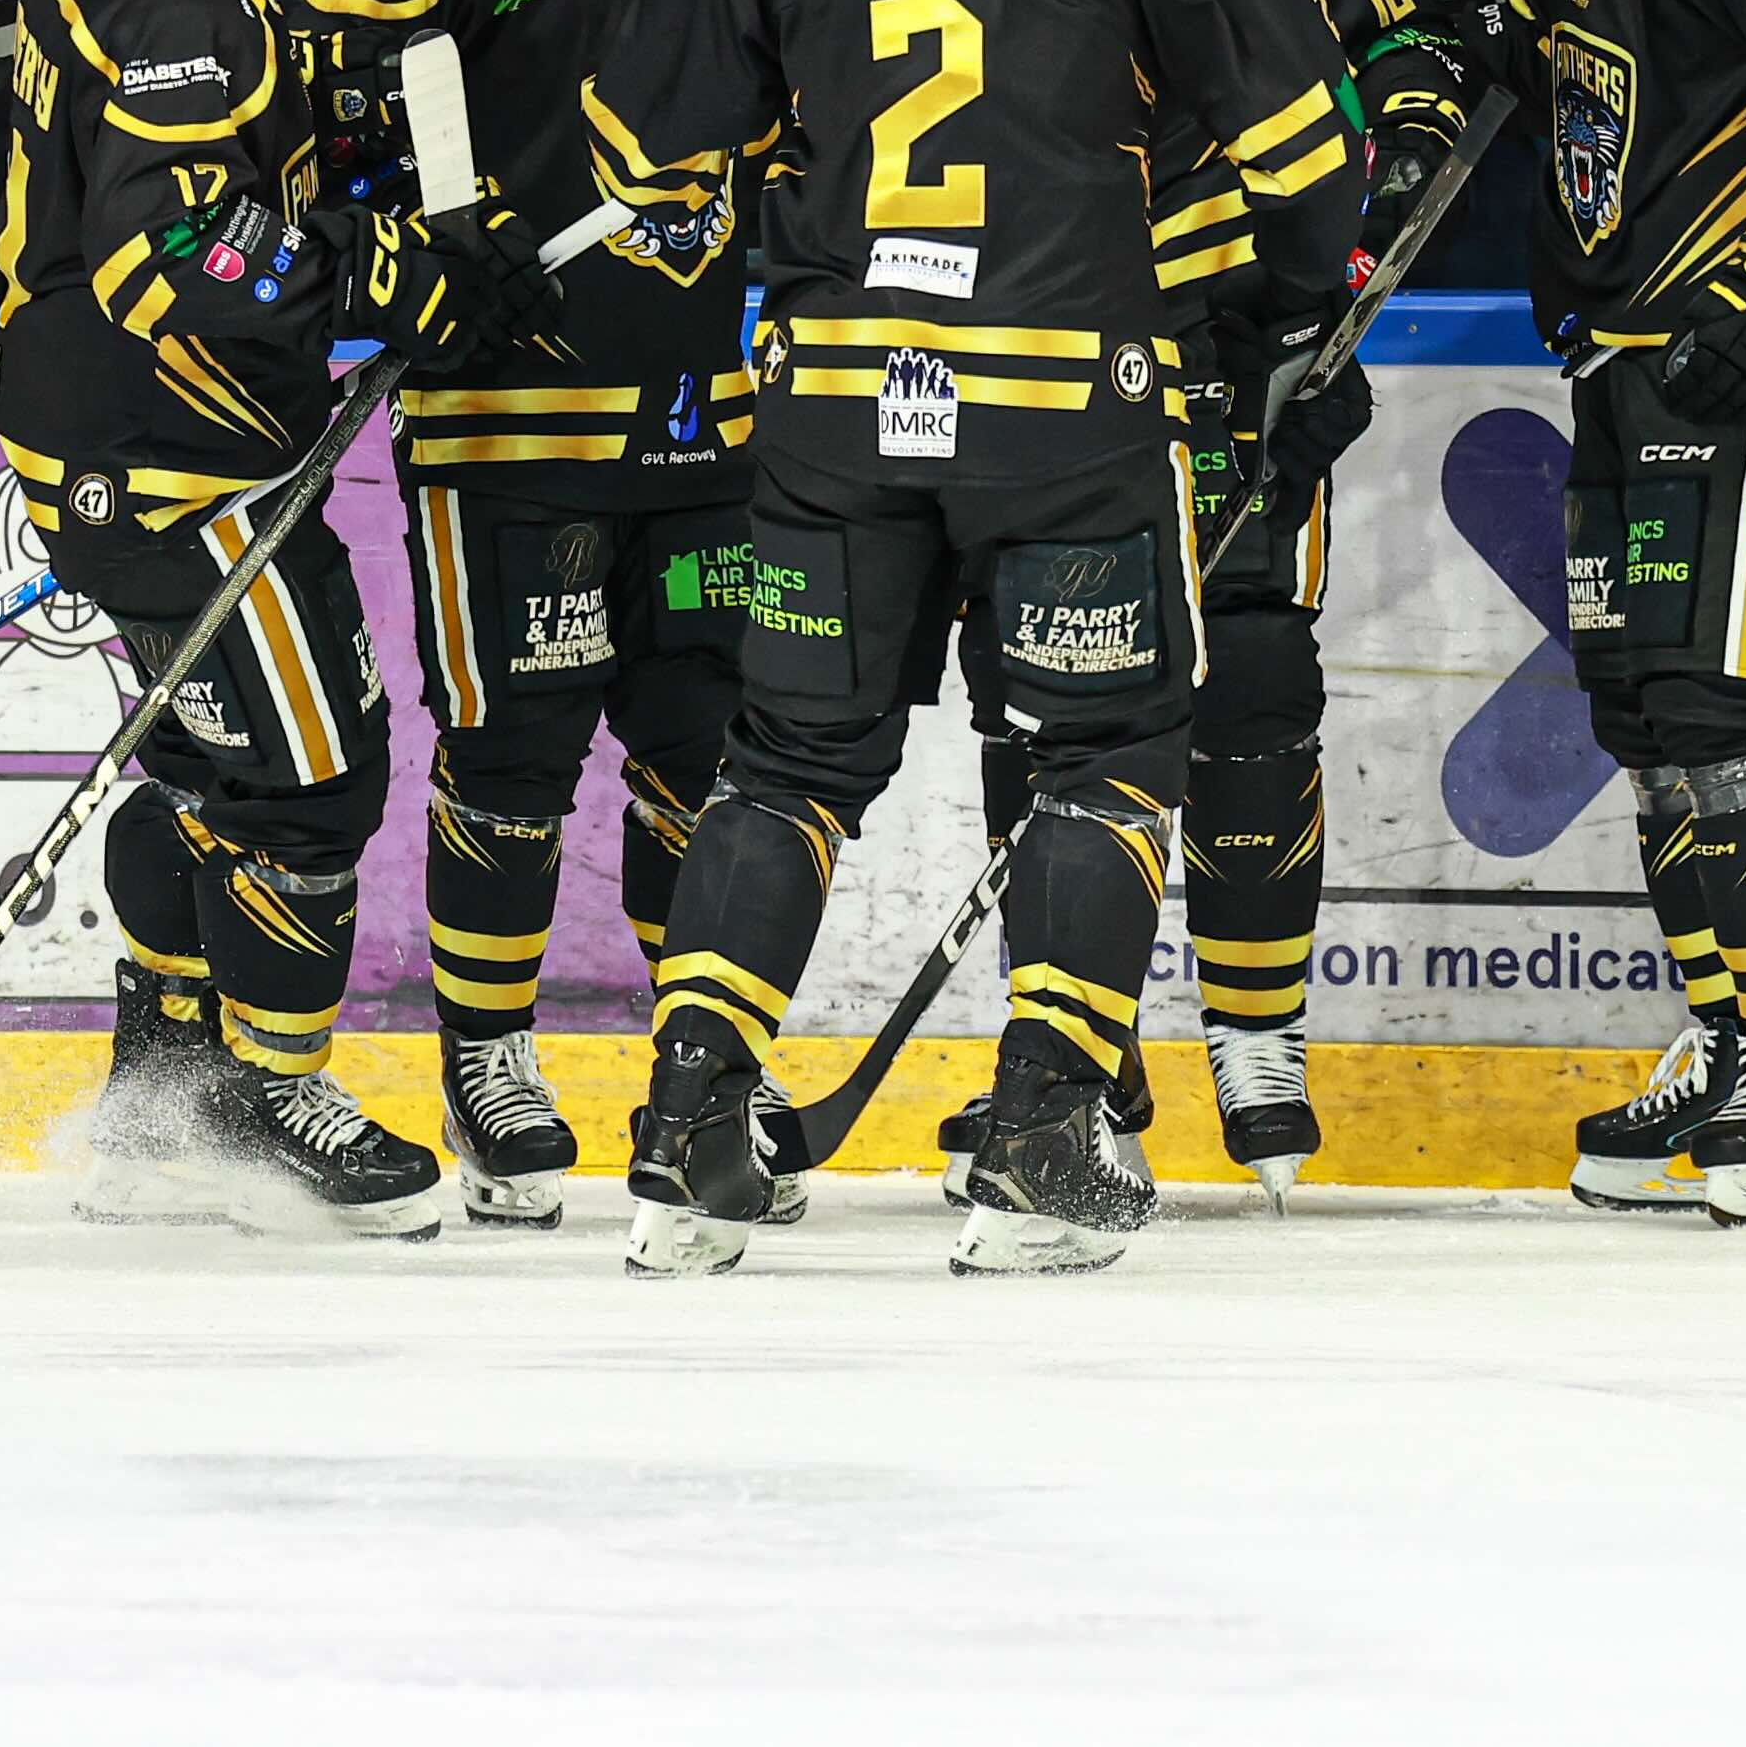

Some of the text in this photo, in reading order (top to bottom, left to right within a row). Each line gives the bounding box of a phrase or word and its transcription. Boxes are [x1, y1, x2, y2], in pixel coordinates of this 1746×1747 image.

[172, 162, 229, 207] 17
[211, 251, 233, 276] NBS
[1122, 359, 1144, 385] 47
[641, 453, 665, 466] GVL
[1639, 444, 1718, 463] CCM
[77, 489, 104, 514] 47
[701, 543, 754, 567] LINC
[705, 567, 745, 587] AIR
[754, 559, 806, 591] LINCS
[1568, 556, 1609, 579] ARRY
[1627, 561, 1689, 586] ESTING
[754, 584, 782, 608] AIR
[1568, 579, 1615, 603] AMILY
[526, 596, 551, 621] TJ
[755, 604, 844, 637] TESTING
[1019, 600, 1141, 627] TJ PARRY
[525, 620, 546, 644] &
[1016, 619, 1141, 648] & FAMILY
[510, 650, 580, 673] FUNERAL
[1003, 644, 1157, 674] FUNERAL DIRECTORS
[1022, 640, 1134, 662] INDEPENDENT
[494, 824, 547, 841] CCM
[1214, 834, 1275, 847] CCM
[1425, 932, 1688, 993] medicat
